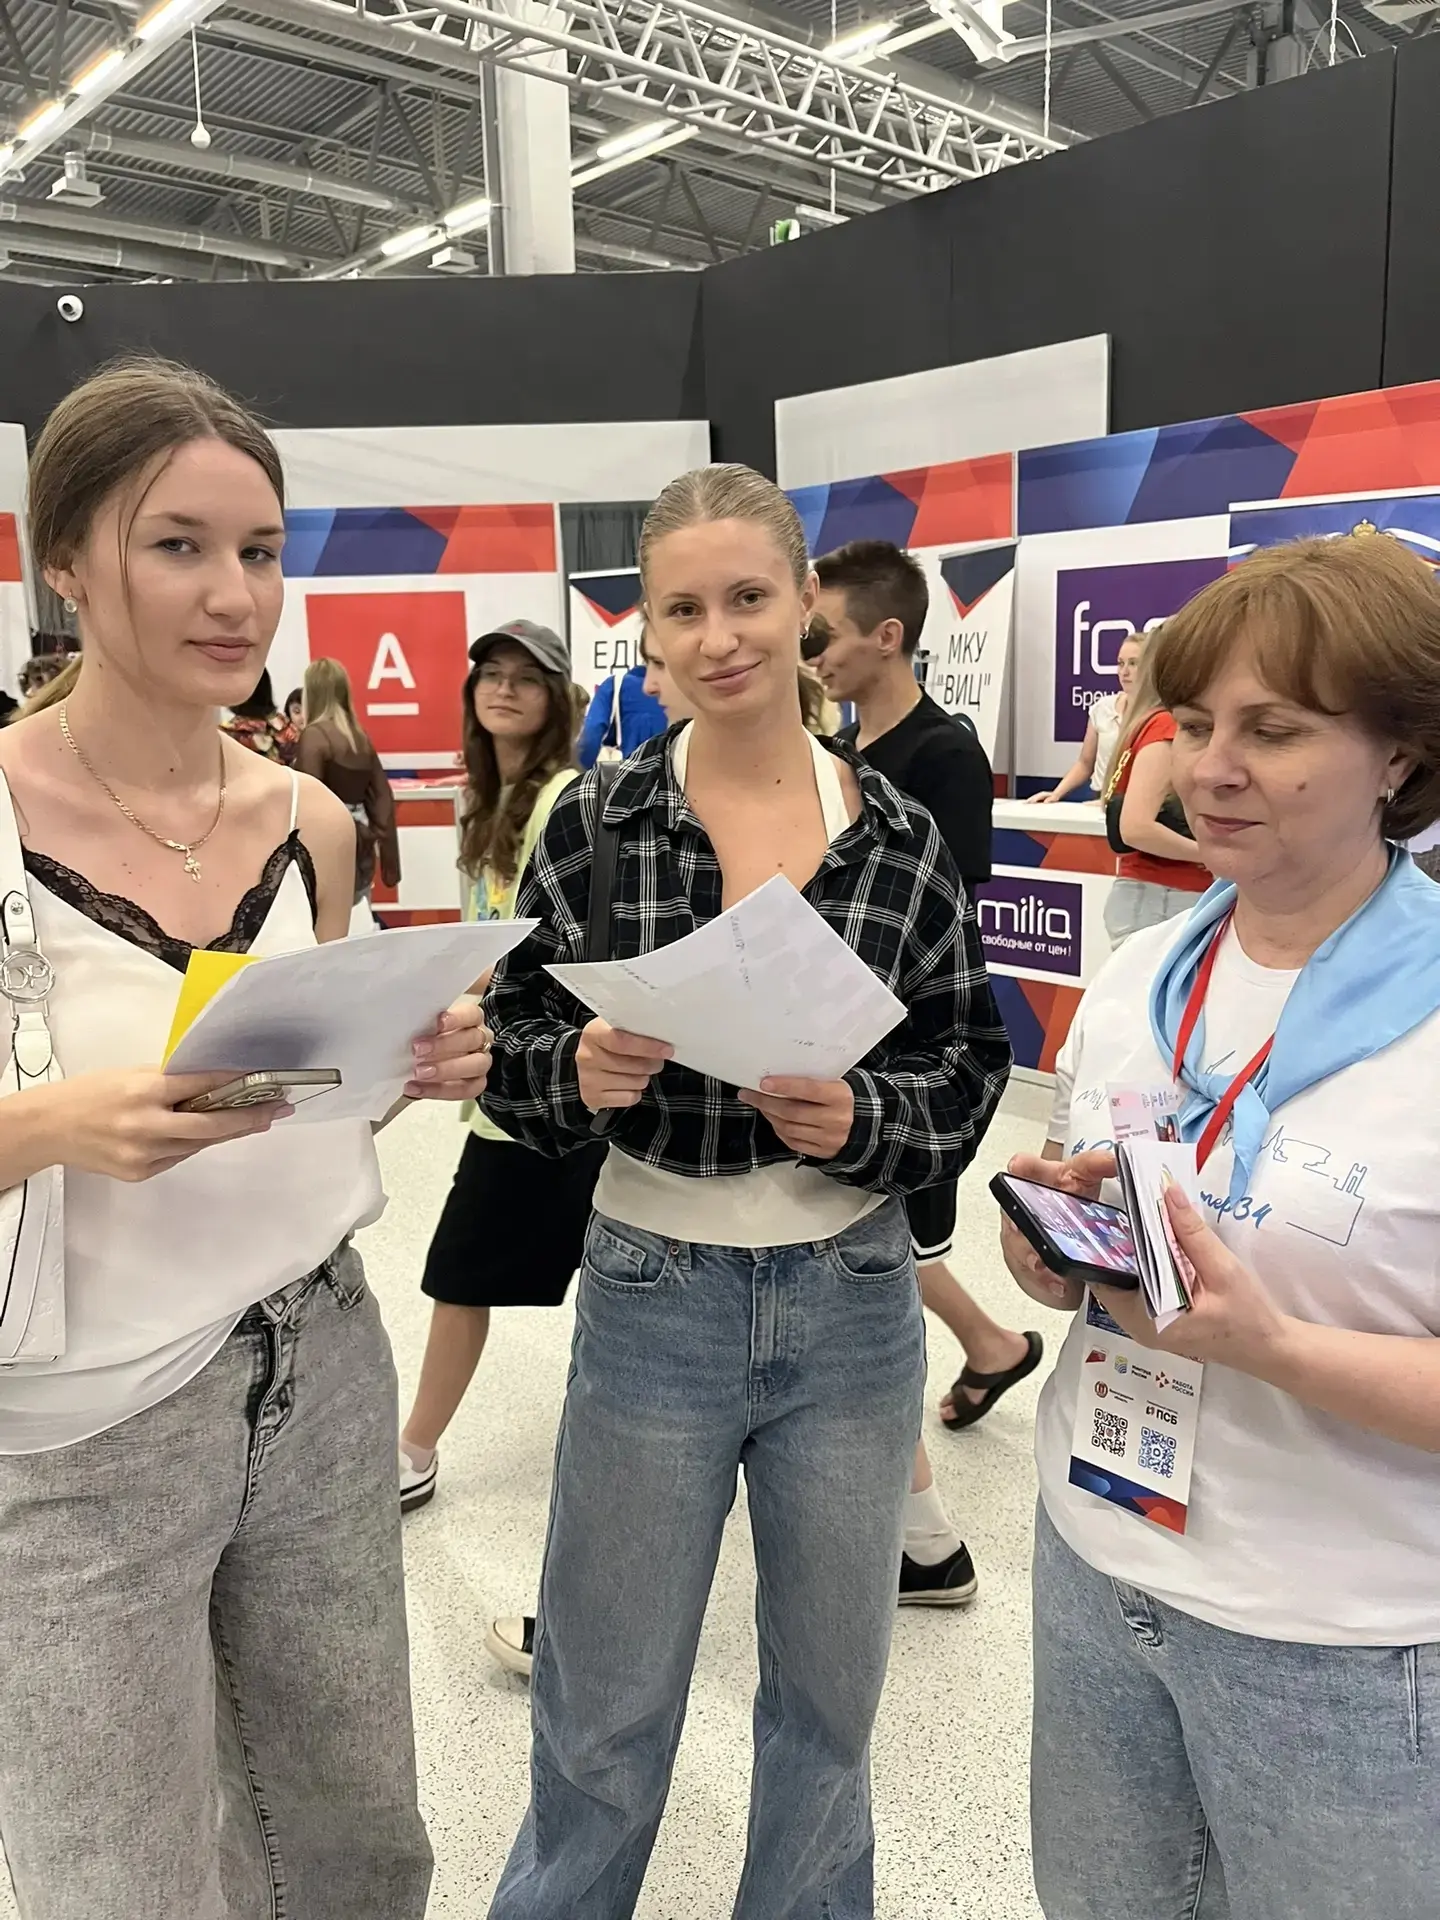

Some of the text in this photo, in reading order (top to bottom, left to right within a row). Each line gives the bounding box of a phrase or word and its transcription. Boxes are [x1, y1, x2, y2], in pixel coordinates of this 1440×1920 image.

[947, 631, 988, 665] МКУ
[936, 673, 991, 713] "ВИЦ"
[1072, 686, 1115, 711] Бре
[982, 934, 1033, 951] свободные
[1034, 942, 1046, 953] от
[1156, 1408, 1179, 1426] ПСБ
